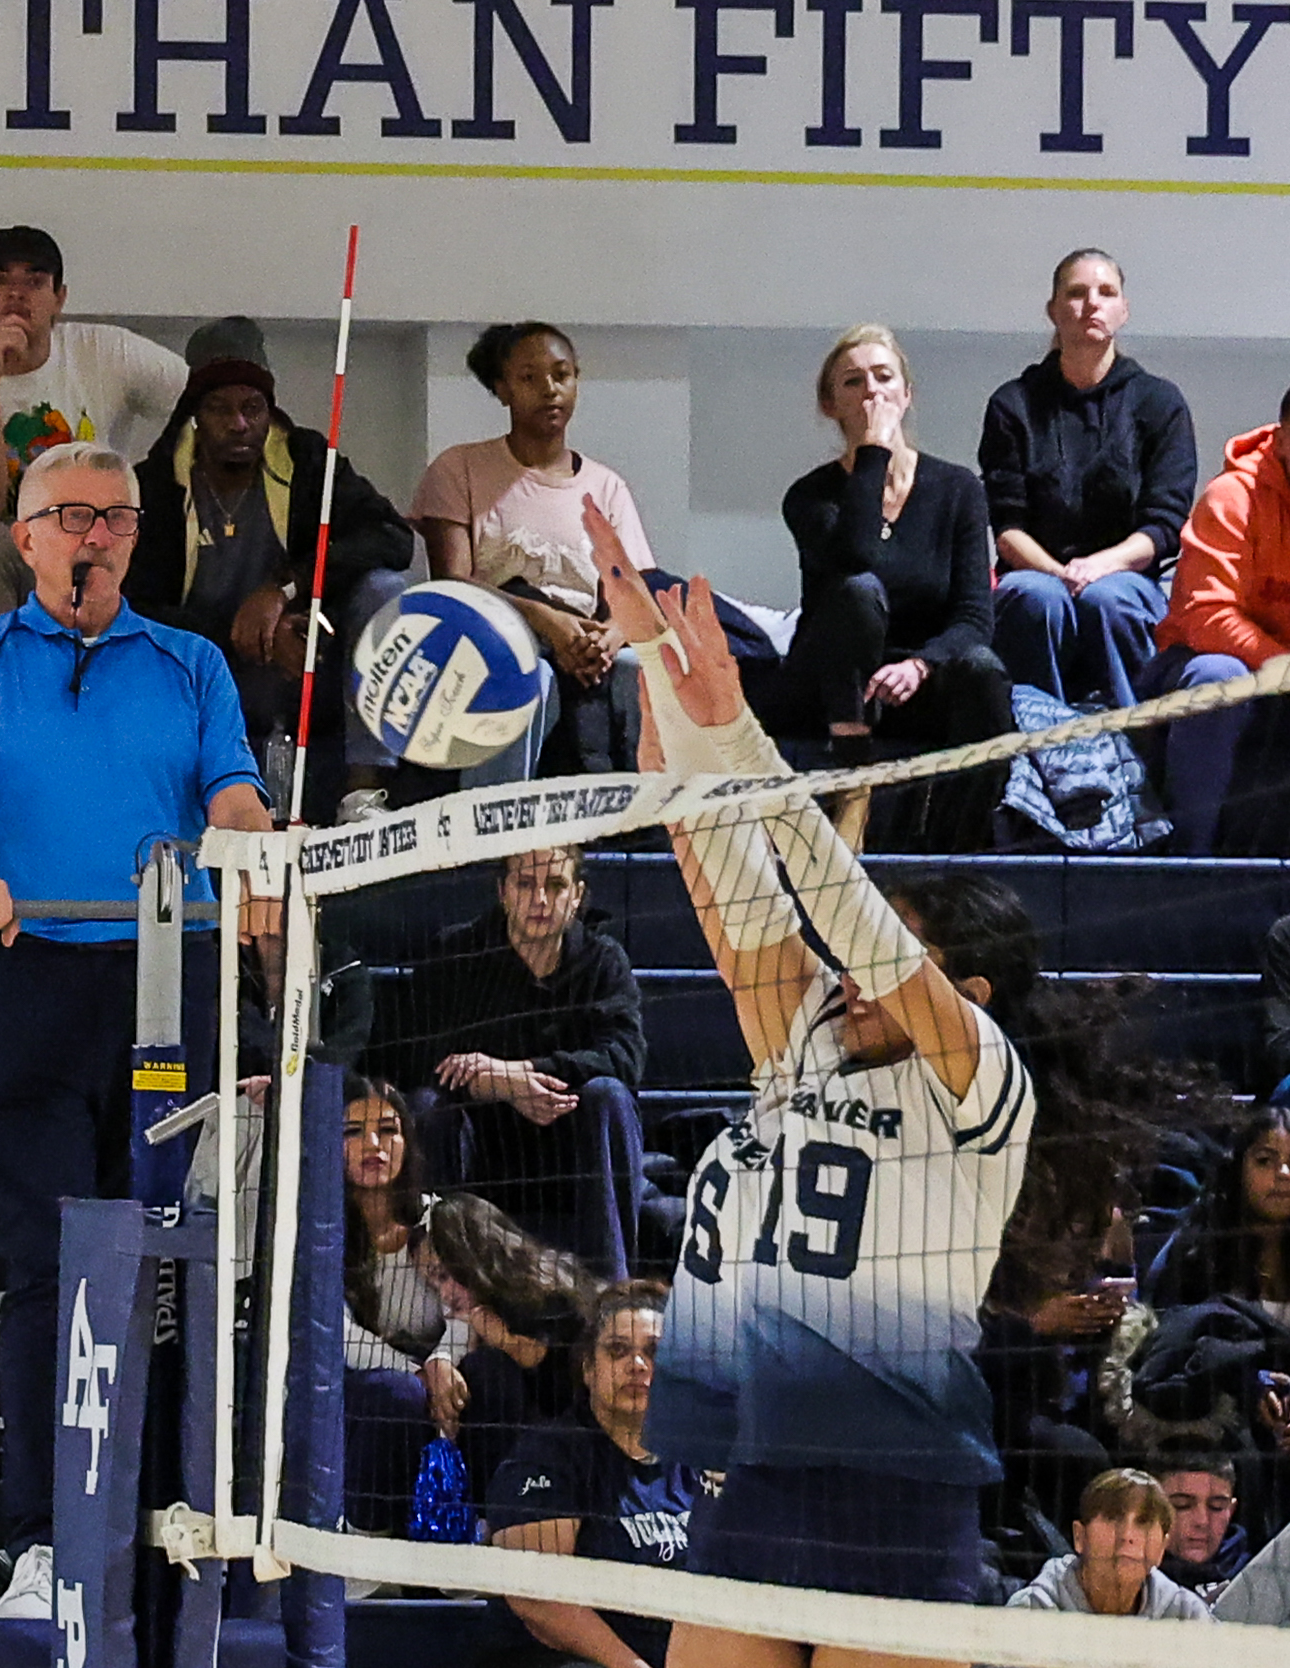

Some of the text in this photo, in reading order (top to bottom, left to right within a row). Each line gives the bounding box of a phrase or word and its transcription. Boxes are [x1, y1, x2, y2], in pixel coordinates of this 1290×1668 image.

[675, 0, 1290, 156] FIFTY
[364, 627, 413, 722] molten
[753, 1131, 873, 1280] 19
